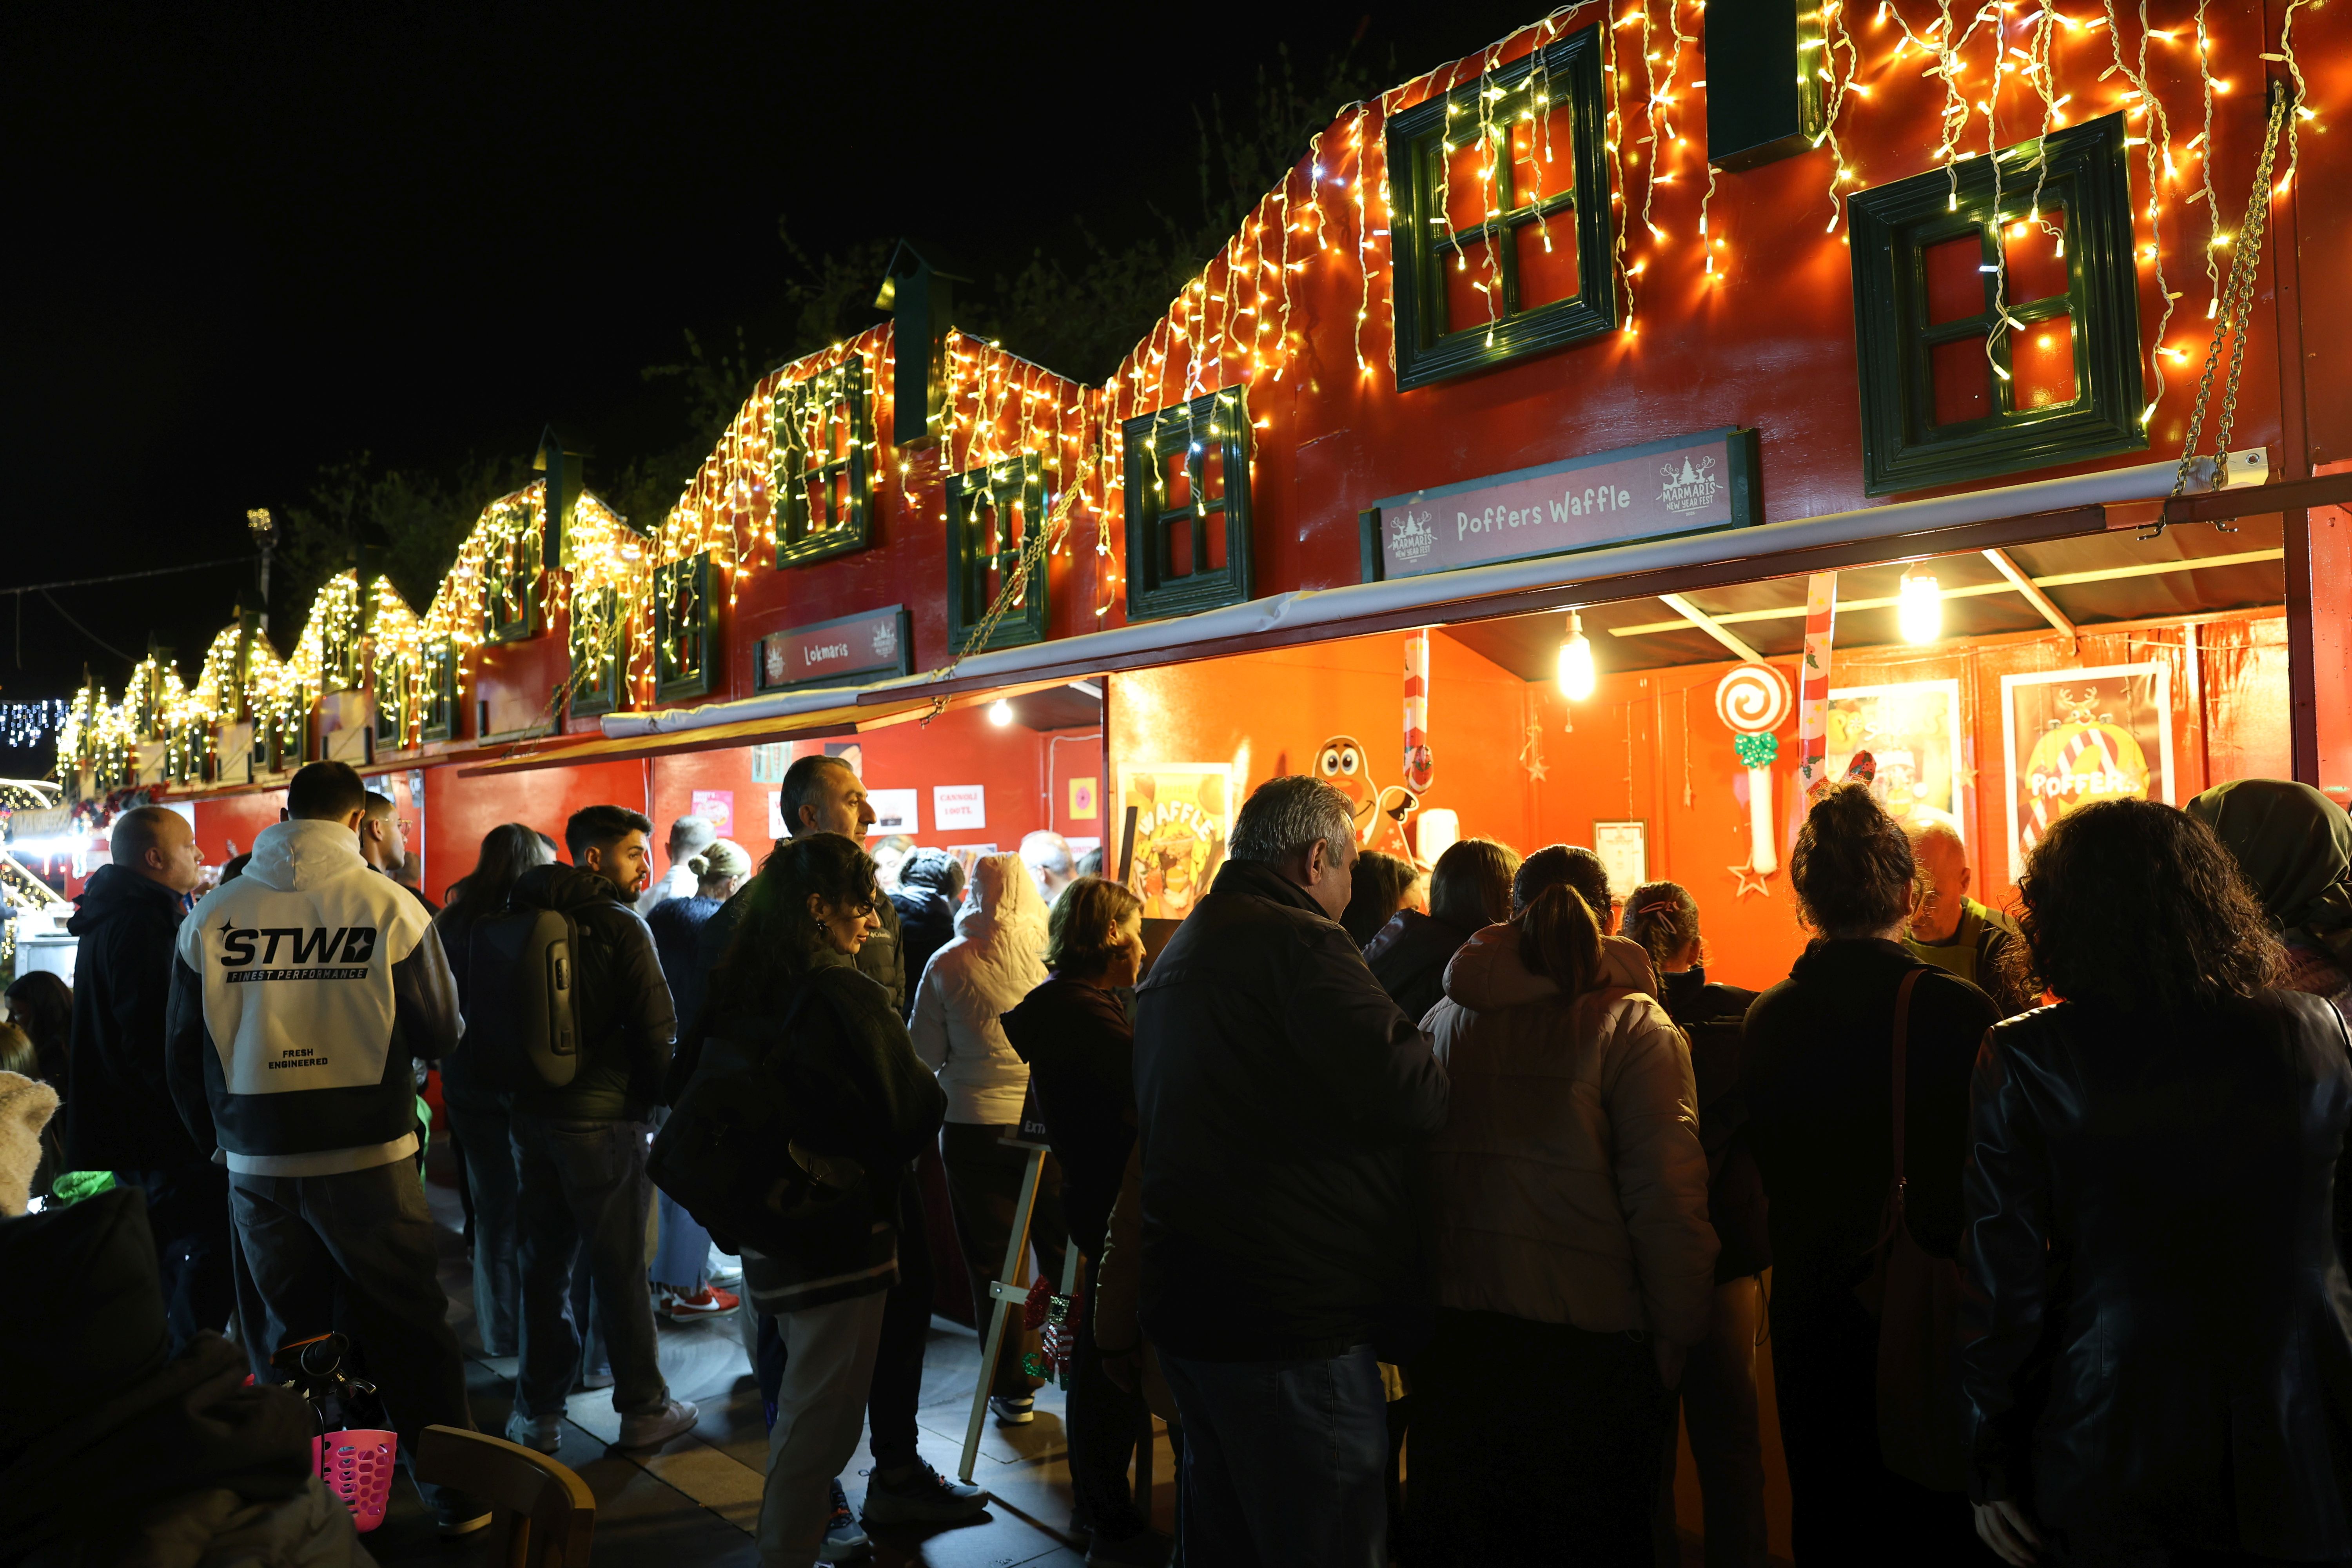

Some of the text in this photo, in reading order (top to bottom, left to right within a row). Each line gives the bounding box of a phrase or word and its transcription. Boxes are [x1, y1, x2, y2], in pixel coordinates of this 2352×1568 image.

[1666, 495, 1713, 511] NEW YEAR FEST
[1457, 485, 1631, 541] Poffers Waffle
[1396, 545, 1430, 558] NEW YEAR FEST
[804, 643, 849, 666] Lokmaris
[1138, 800, 1214, 842] WAFFLE
[221, 927, 377, 966] STWD
[231, 969, 364, 982] FINEST PERFORMANCE
[283, 1048, 314, 1058] FRESH
[269, 1058, 328, 1069] ENGINEERED
